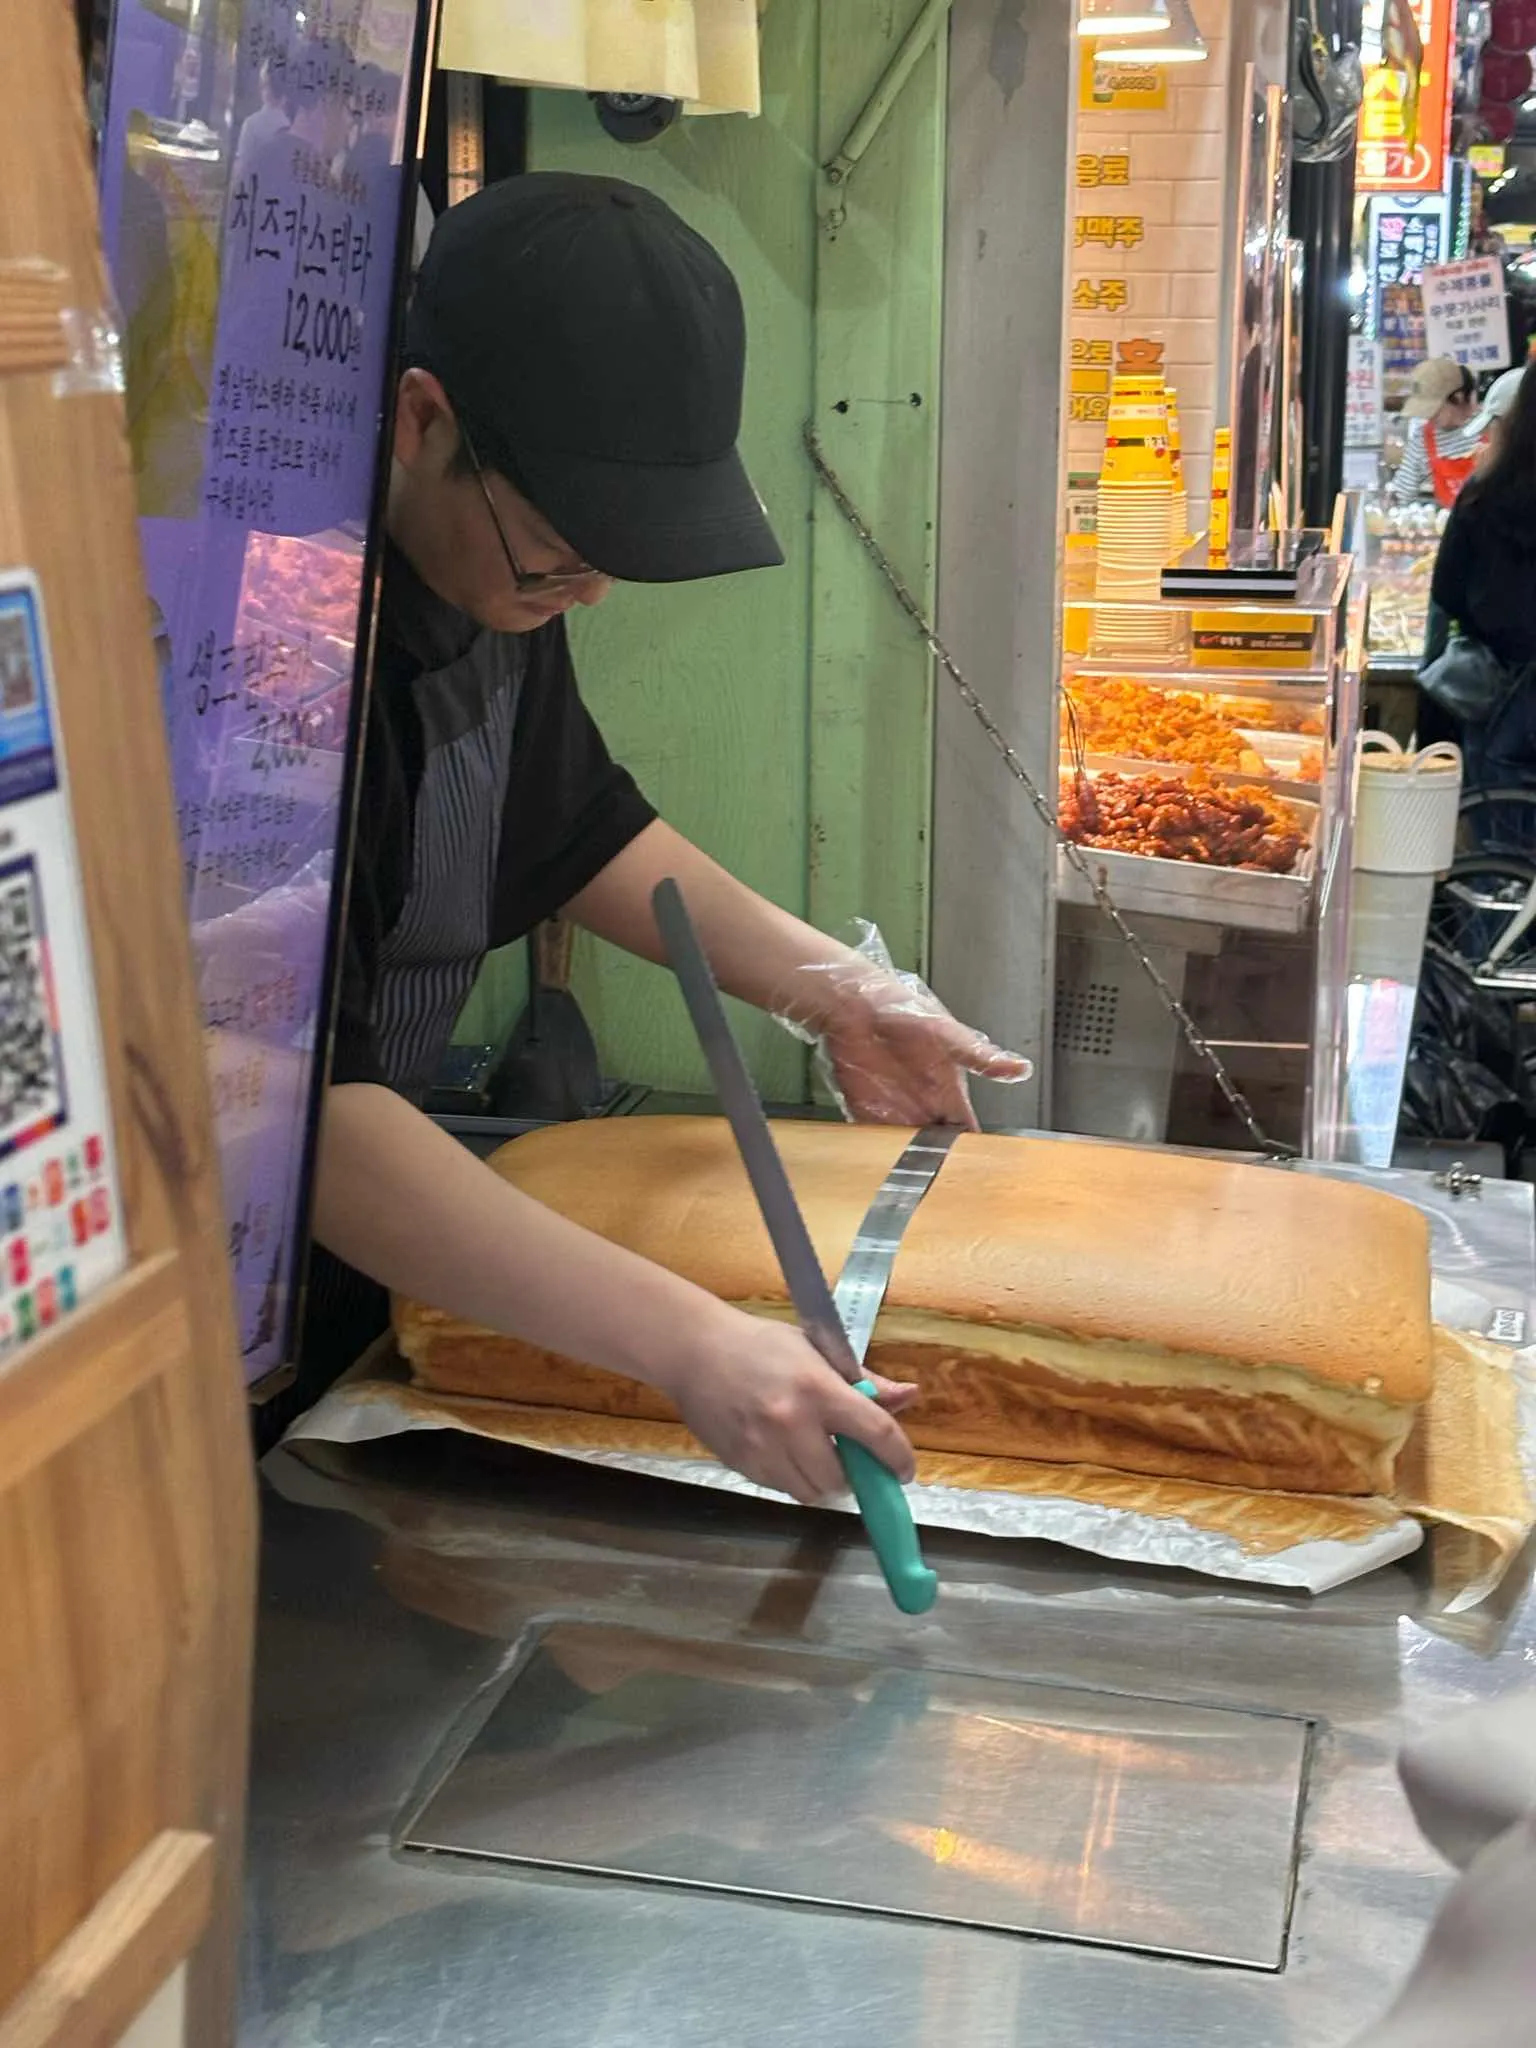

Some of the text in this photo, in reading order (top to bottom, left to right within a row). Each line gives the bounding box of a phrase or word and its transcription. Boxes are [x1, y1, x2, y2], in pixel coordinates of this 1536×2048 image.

[1075, 153, 1130, 188] 음료
[230, 173, 373, 299] 치즈카스테라
[1071, 279, 1128, 312] 소주
